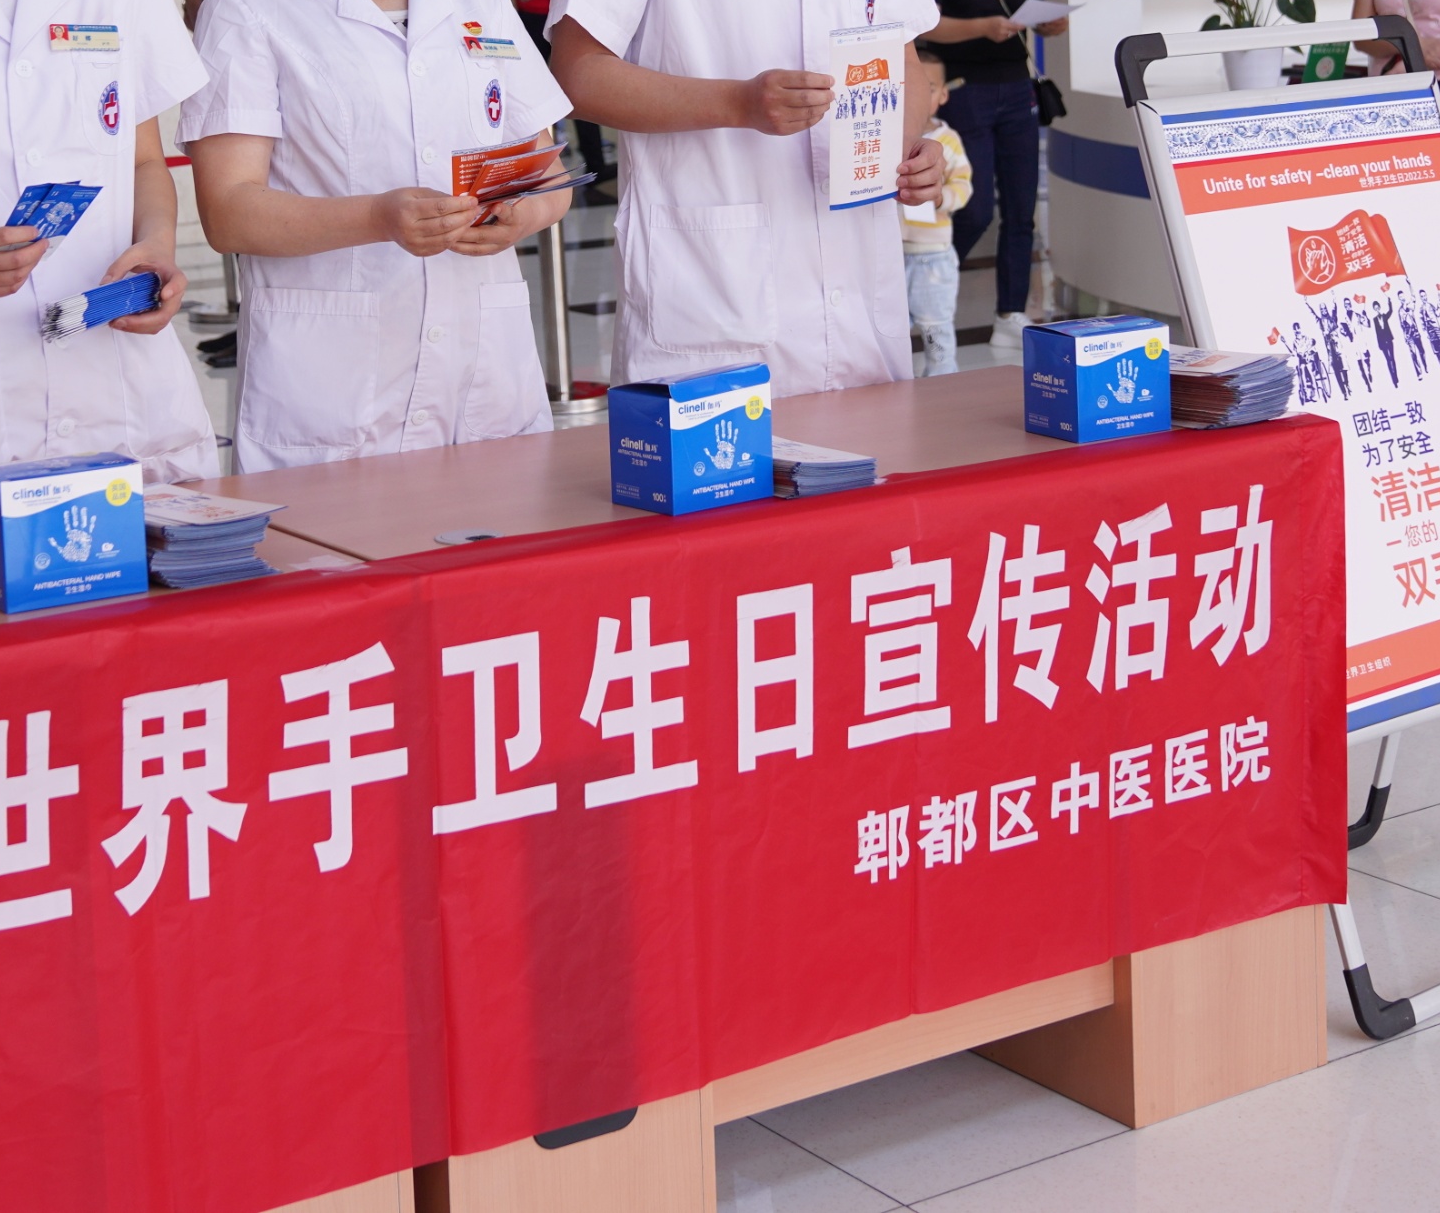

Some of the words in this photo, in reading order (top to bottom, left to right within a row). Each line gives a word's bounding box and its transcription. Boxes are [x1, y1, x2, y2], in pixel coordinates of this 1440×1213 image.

[853, 119, 882, 130] 团结一致
[853, 128, 881, 139] 为了安全
[854, 139, 881, 156] 清洁
[854, 164, 881, 181] 双手
[1203, 177, 1244, 195] Unite
[1246, 174, 1267, 189] for
[1271, 168, 1312, 187] safety
[1361, 158, 1391, 177] your
[1393, 152, 1431, 170] hands
[1359, 170, 1435, 188] 世界手卫生日2022.5.5
[1341, 233, 1368, 255] 清洁
[1345, 254, 1375, 274] 双手
[1084, 341, 1108, 352] clinell
[1033, 372, 1053, 384] clinell
[678, 402, 705, 415] clinell
[1353, 400, 1427, 438] 团结一致
[621, 437, 643, 450] clinell
[1362, 432, 1434, 468] 为了安全
[13, 486, 49, 500] clinell
[693, 483, 729, 495] ANTIBACTERIAL
[653, 492, 663, 502] 100
[33, 578, 83, 592] ANTIBACTERIAL
[854, 717, 1271, 885] 郫都区中医医院
